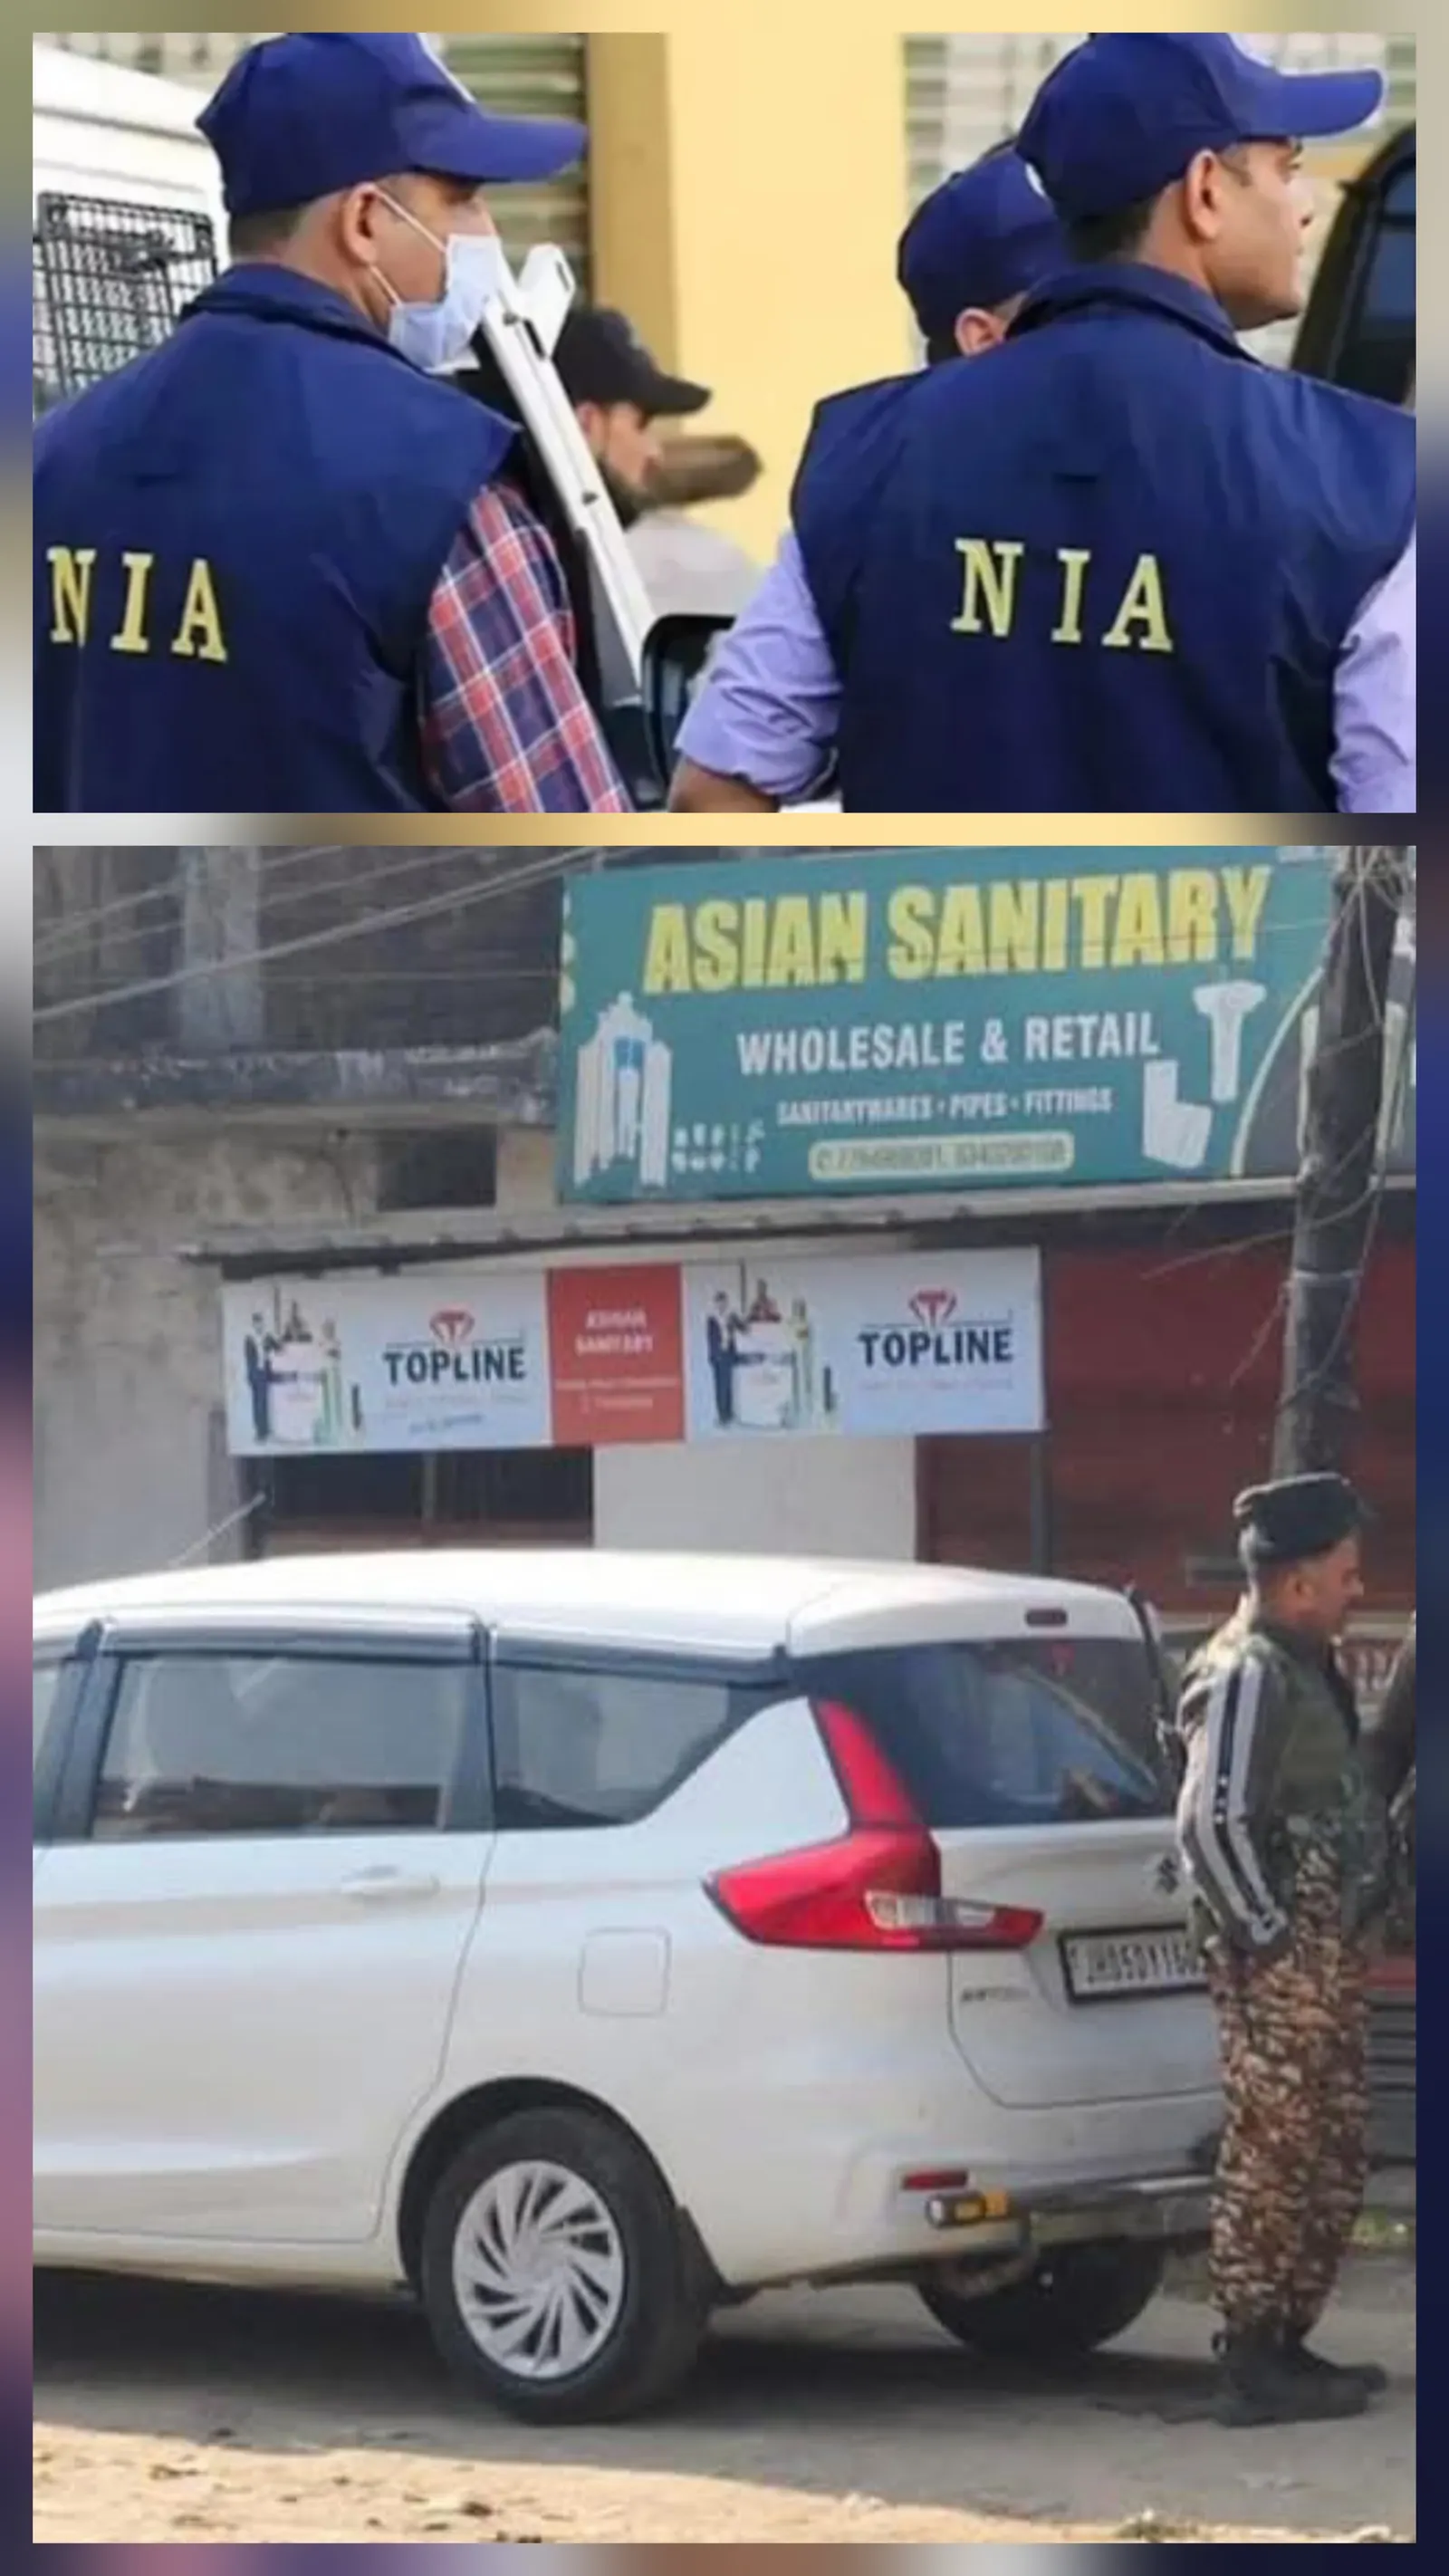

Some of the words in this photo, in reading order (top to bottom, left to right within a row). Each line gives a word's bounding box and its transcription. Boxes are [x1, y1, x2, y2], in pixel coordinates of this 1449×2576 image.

[47, 546, 228, 663] NIA
[952, 538, 1175, 652] NIA
[643, 891, 867, 993] ASIAN
[887, 866, 1271, 981] SANITARY
[737, 1021, 964, 1075] WHOLESALE
[980, 1019, 1008, 1063] &
[1024, 1011, 1160, 1061] RETAIL
[950, 1092, 1007, 1120] PIPES
[1024, 1088, 1112, 1117] FITTINGS
[382, 1346, 527, 1387] TOPLINE
[857, 1329, 1014, 1366] TOPLINE
